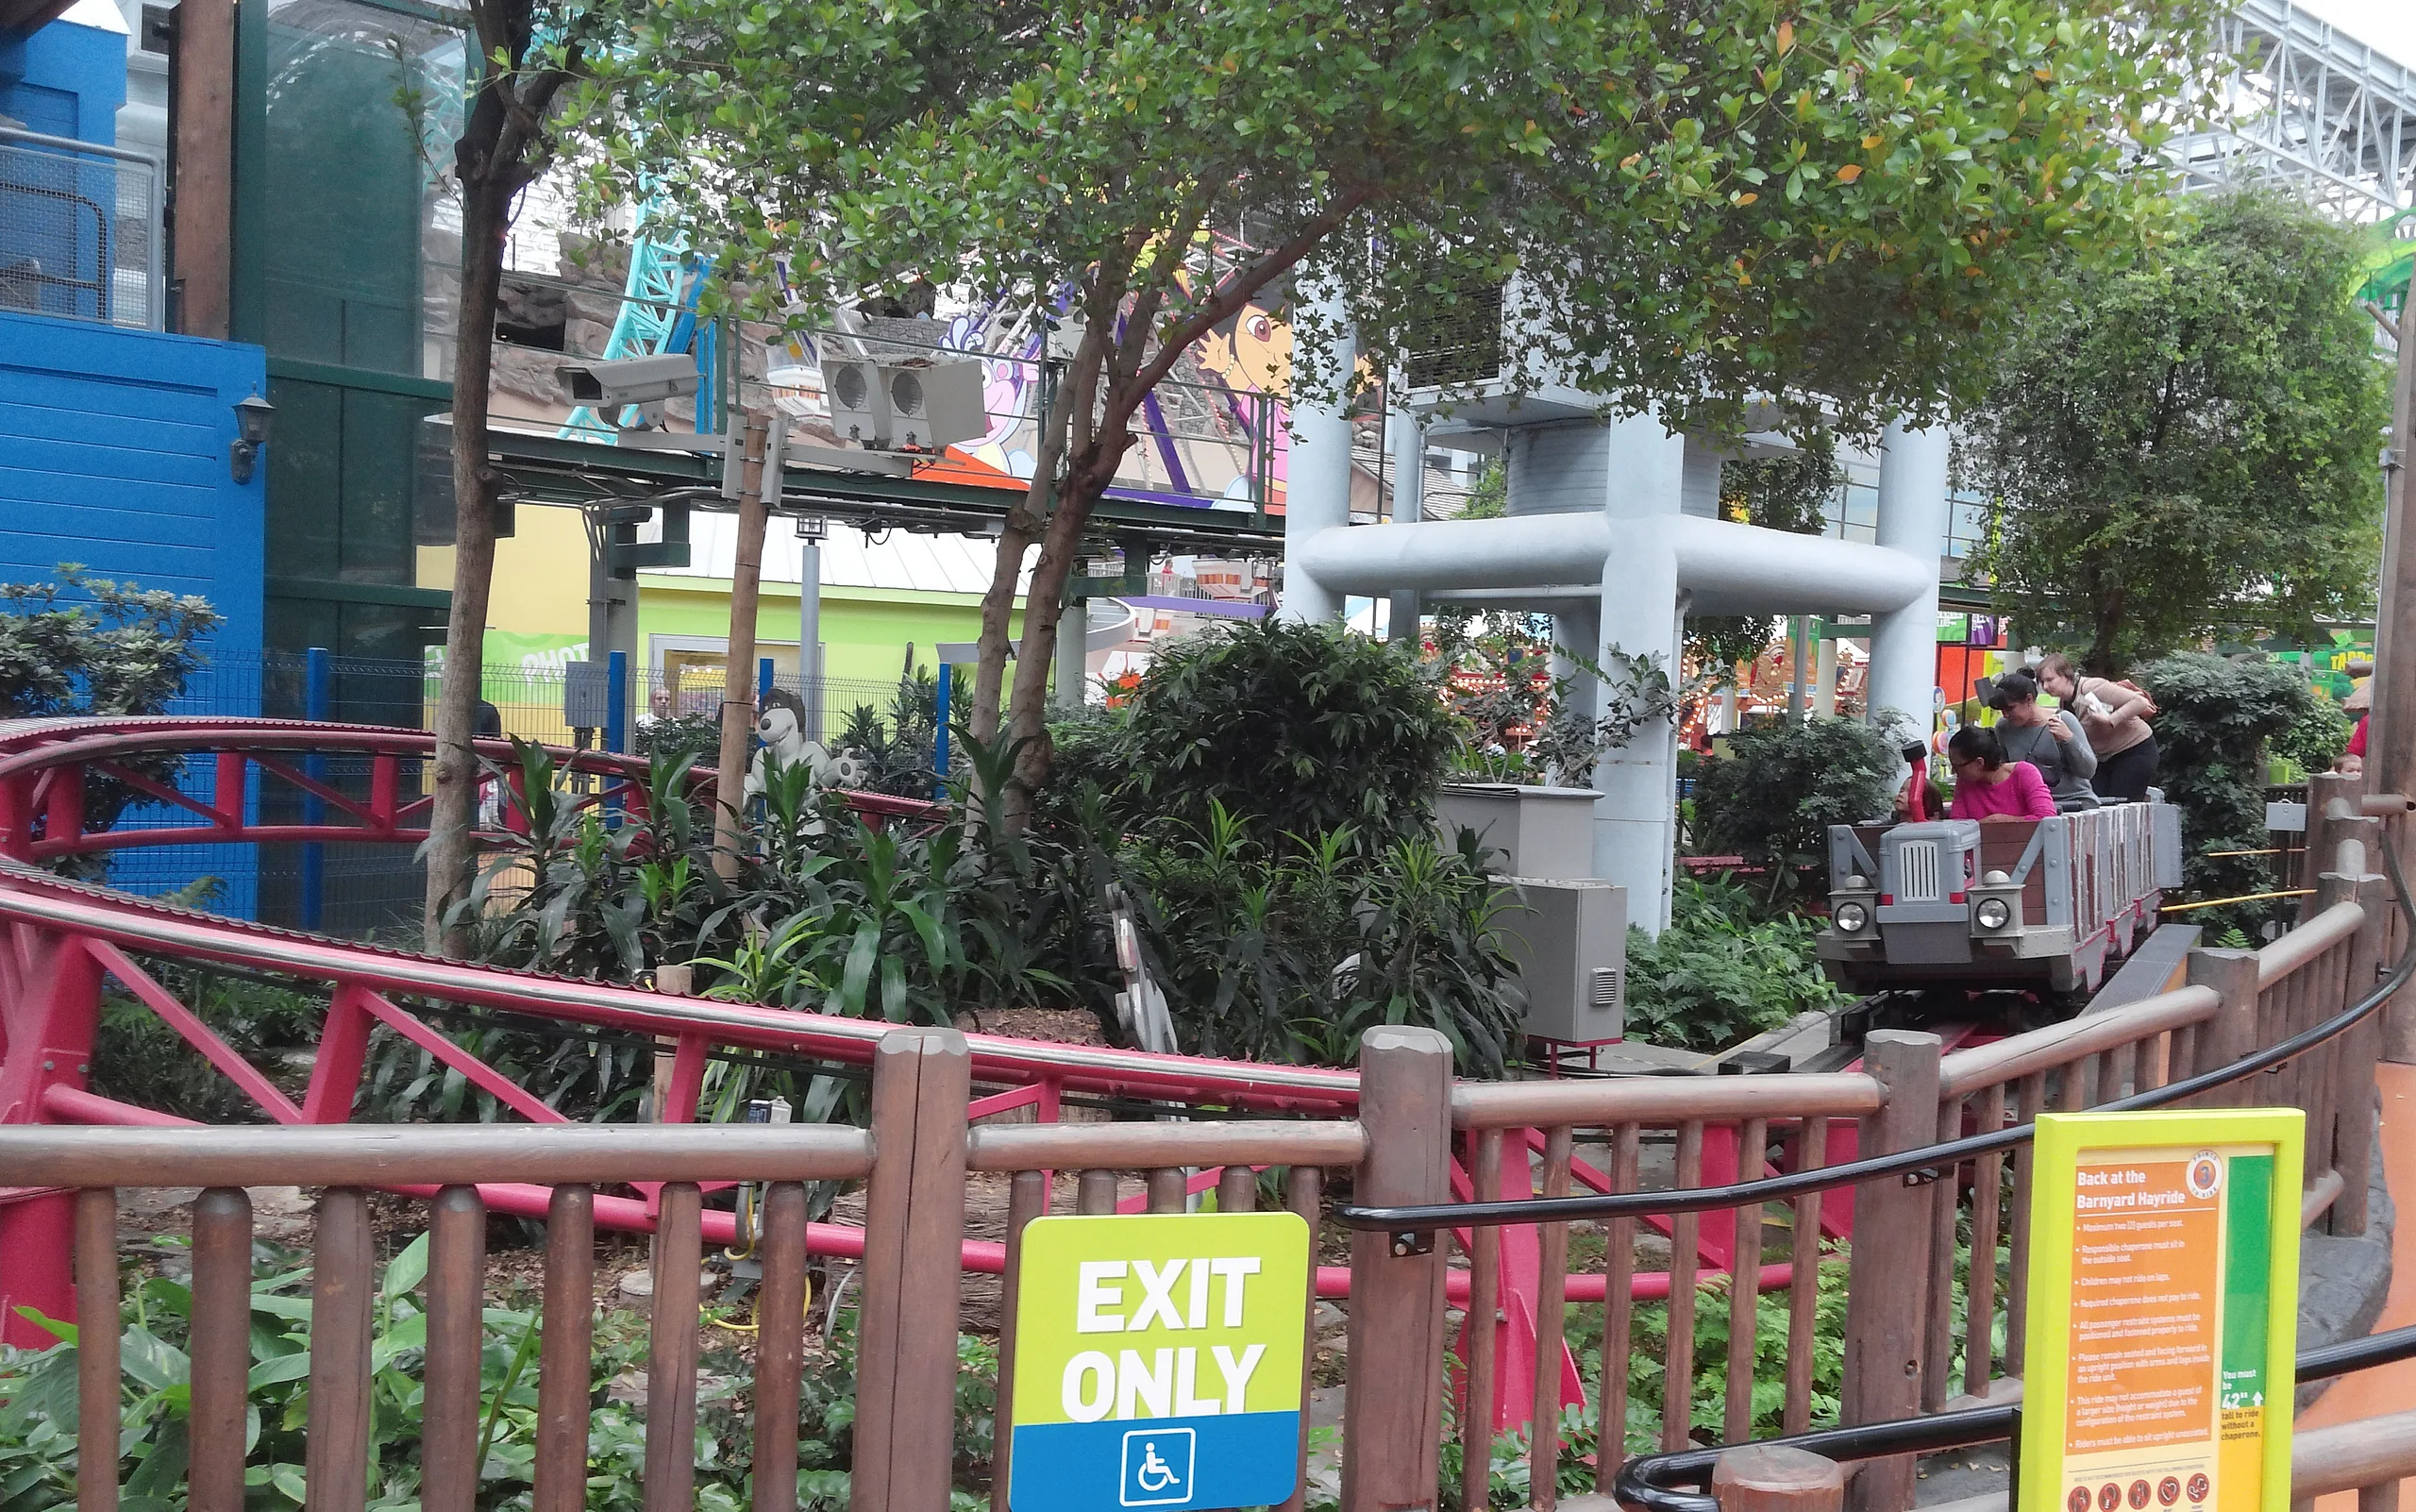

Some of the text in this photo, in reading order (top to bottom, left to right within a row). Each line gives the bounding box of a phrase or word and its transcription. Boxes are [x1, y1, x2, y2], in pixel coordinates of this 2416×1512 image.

[2077, 1170, 2146, 1185] Back at the
[2201, 1166, 2209, 1184] 3
[2077, 1190, 2186, 1210] Barnyard Hayride
[1077, 1257, 1262, 1333] EXIT
[2223, 1369, 2257, 1380] You must
[1062, 1344, 1267, 1422] ONLY
[2222, 1381, 2233, 1389] be
[2222, 1421, 2248, 1430] without
[2222, 1431, 2261, 1441] chaperone.
